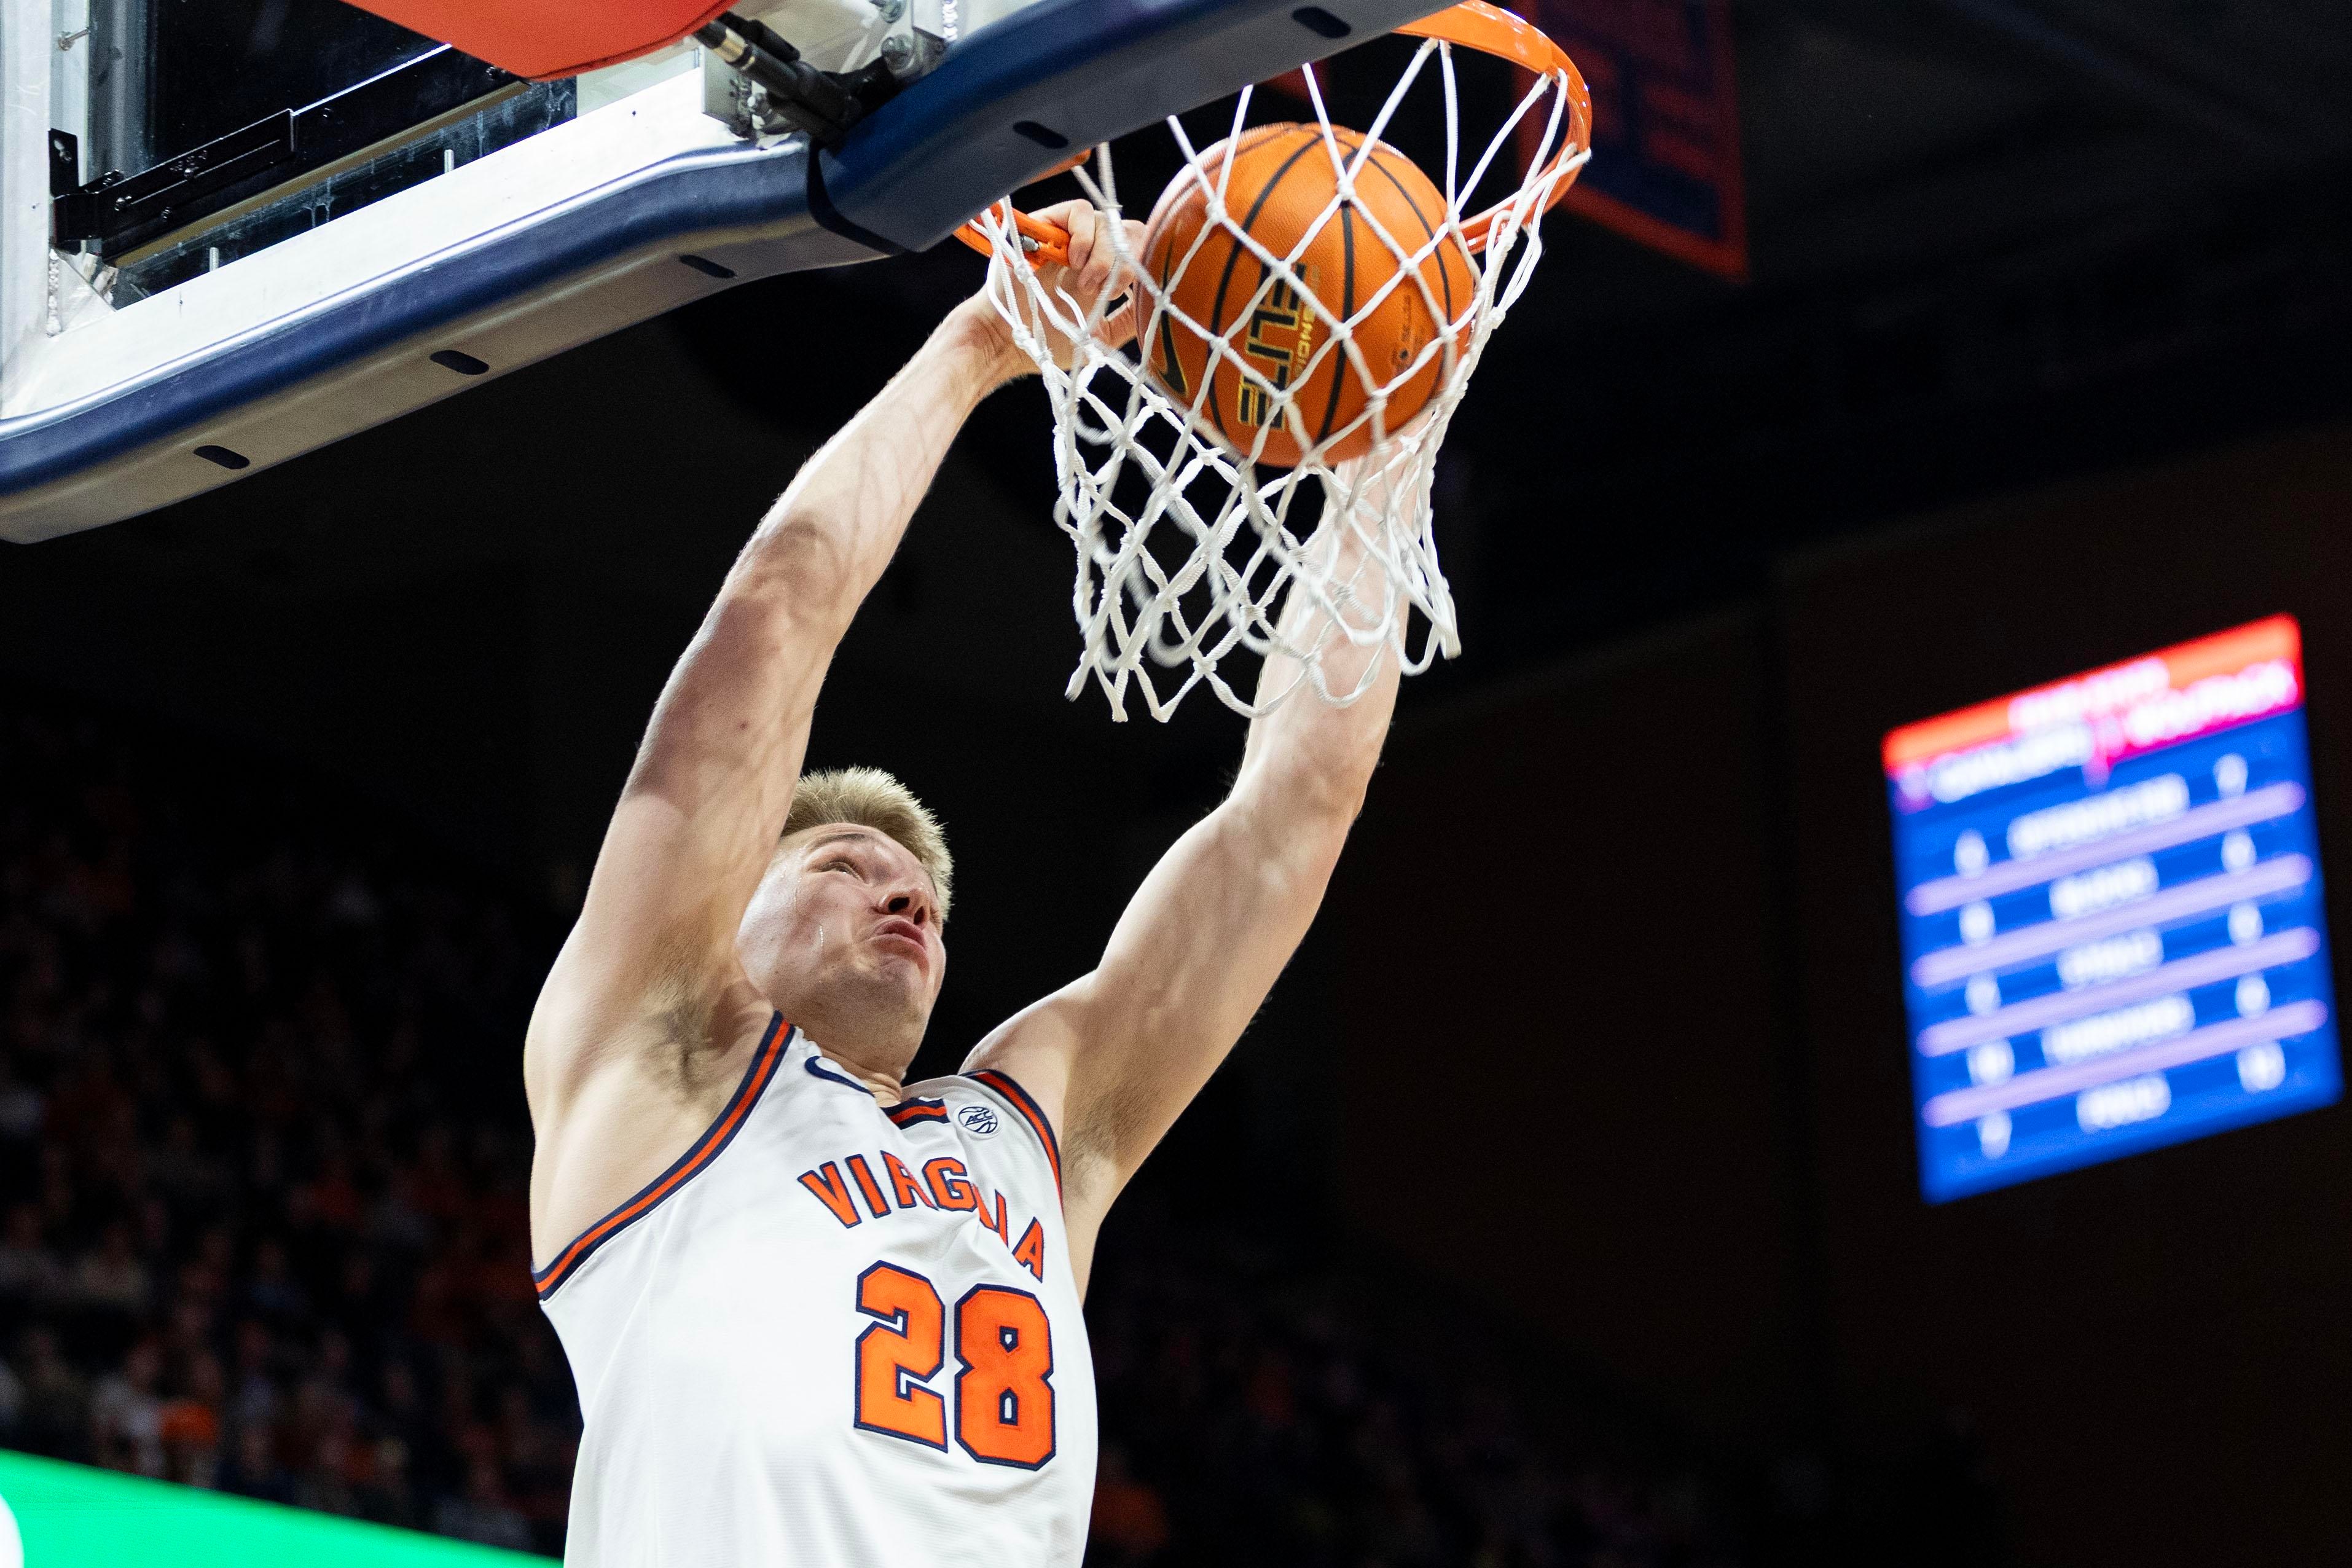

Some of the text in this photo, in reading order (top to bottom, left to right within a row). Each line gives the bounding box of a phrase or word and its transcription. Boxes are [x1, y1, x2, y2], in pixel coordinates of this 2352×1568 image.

[1237, 259, 1307, 431] ELITE
[797, 1150, 1045, 1284] VIRGIA
[853, 1260, 1056, 1471] 28
